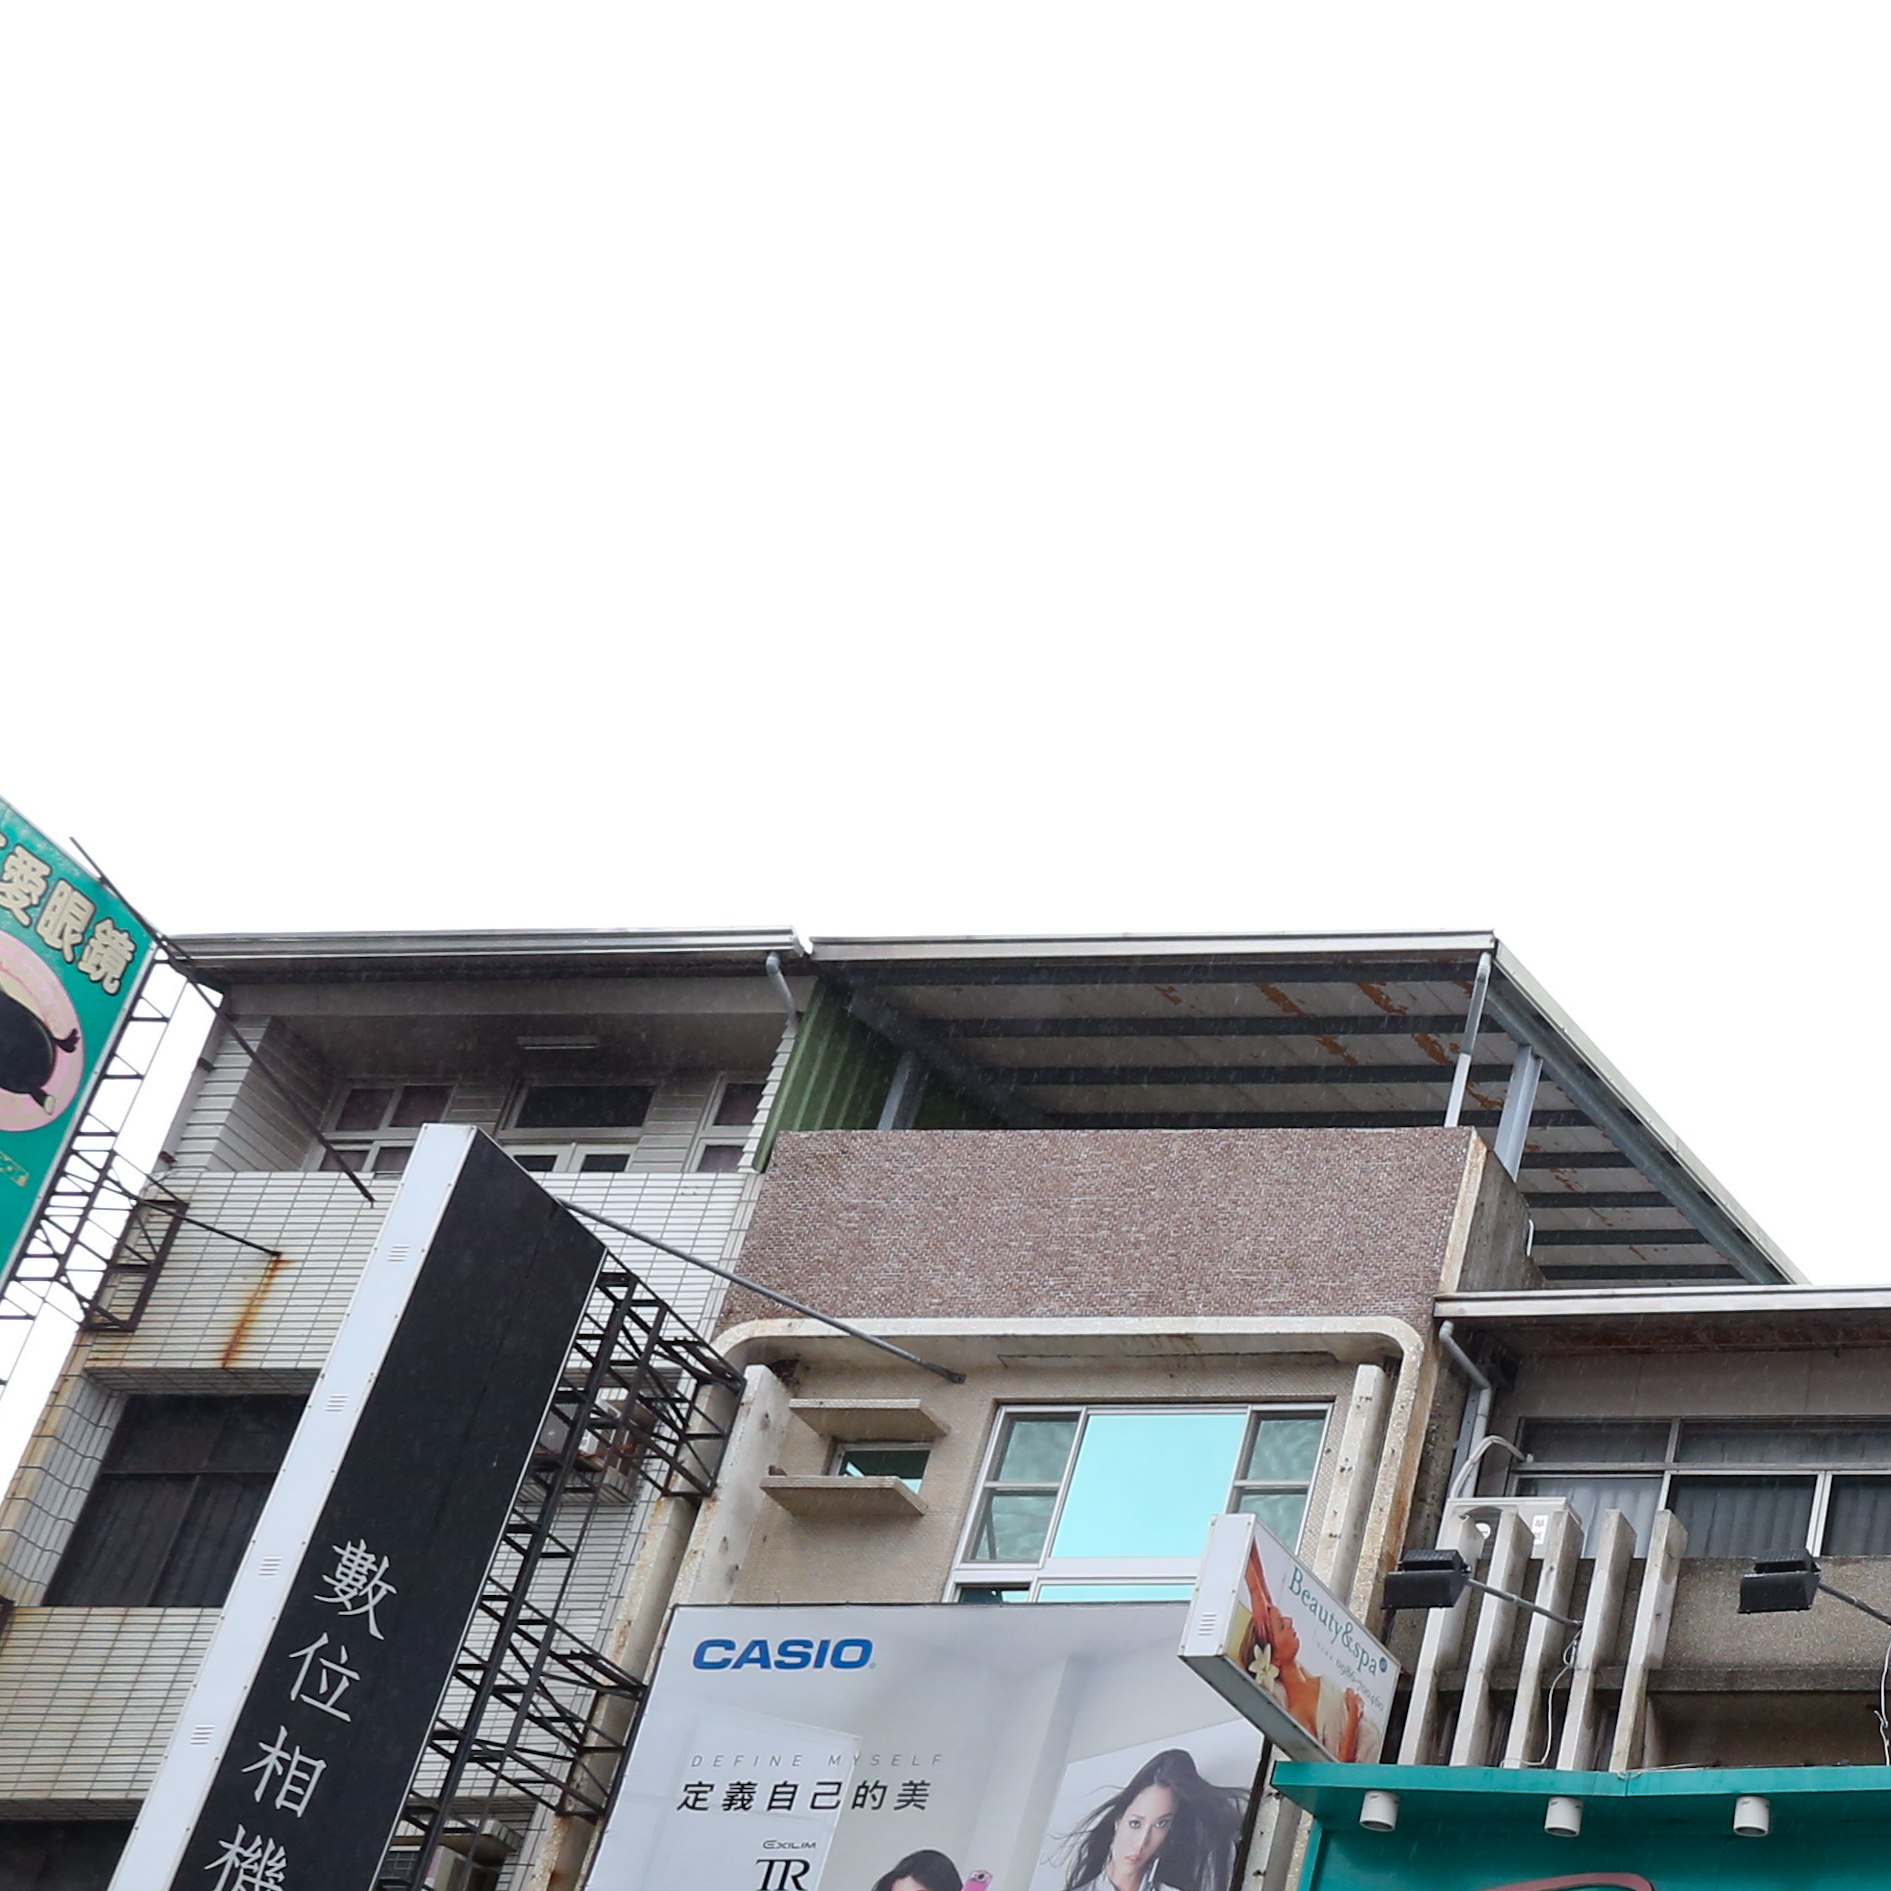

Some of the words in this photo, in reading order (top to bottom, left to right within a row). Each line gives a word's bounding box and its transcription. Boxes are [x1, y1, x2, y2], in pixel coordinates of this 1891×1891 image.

[0, 830, 137, 995] 愛眼鏡
[691, 1637, 874, 1671] CASIO
[690, 1754, 803, 1768] DEFINE
[827, 1753, 943, 1767] MYSELF
[676, 1779, 932, 1812] 定義自己的美
